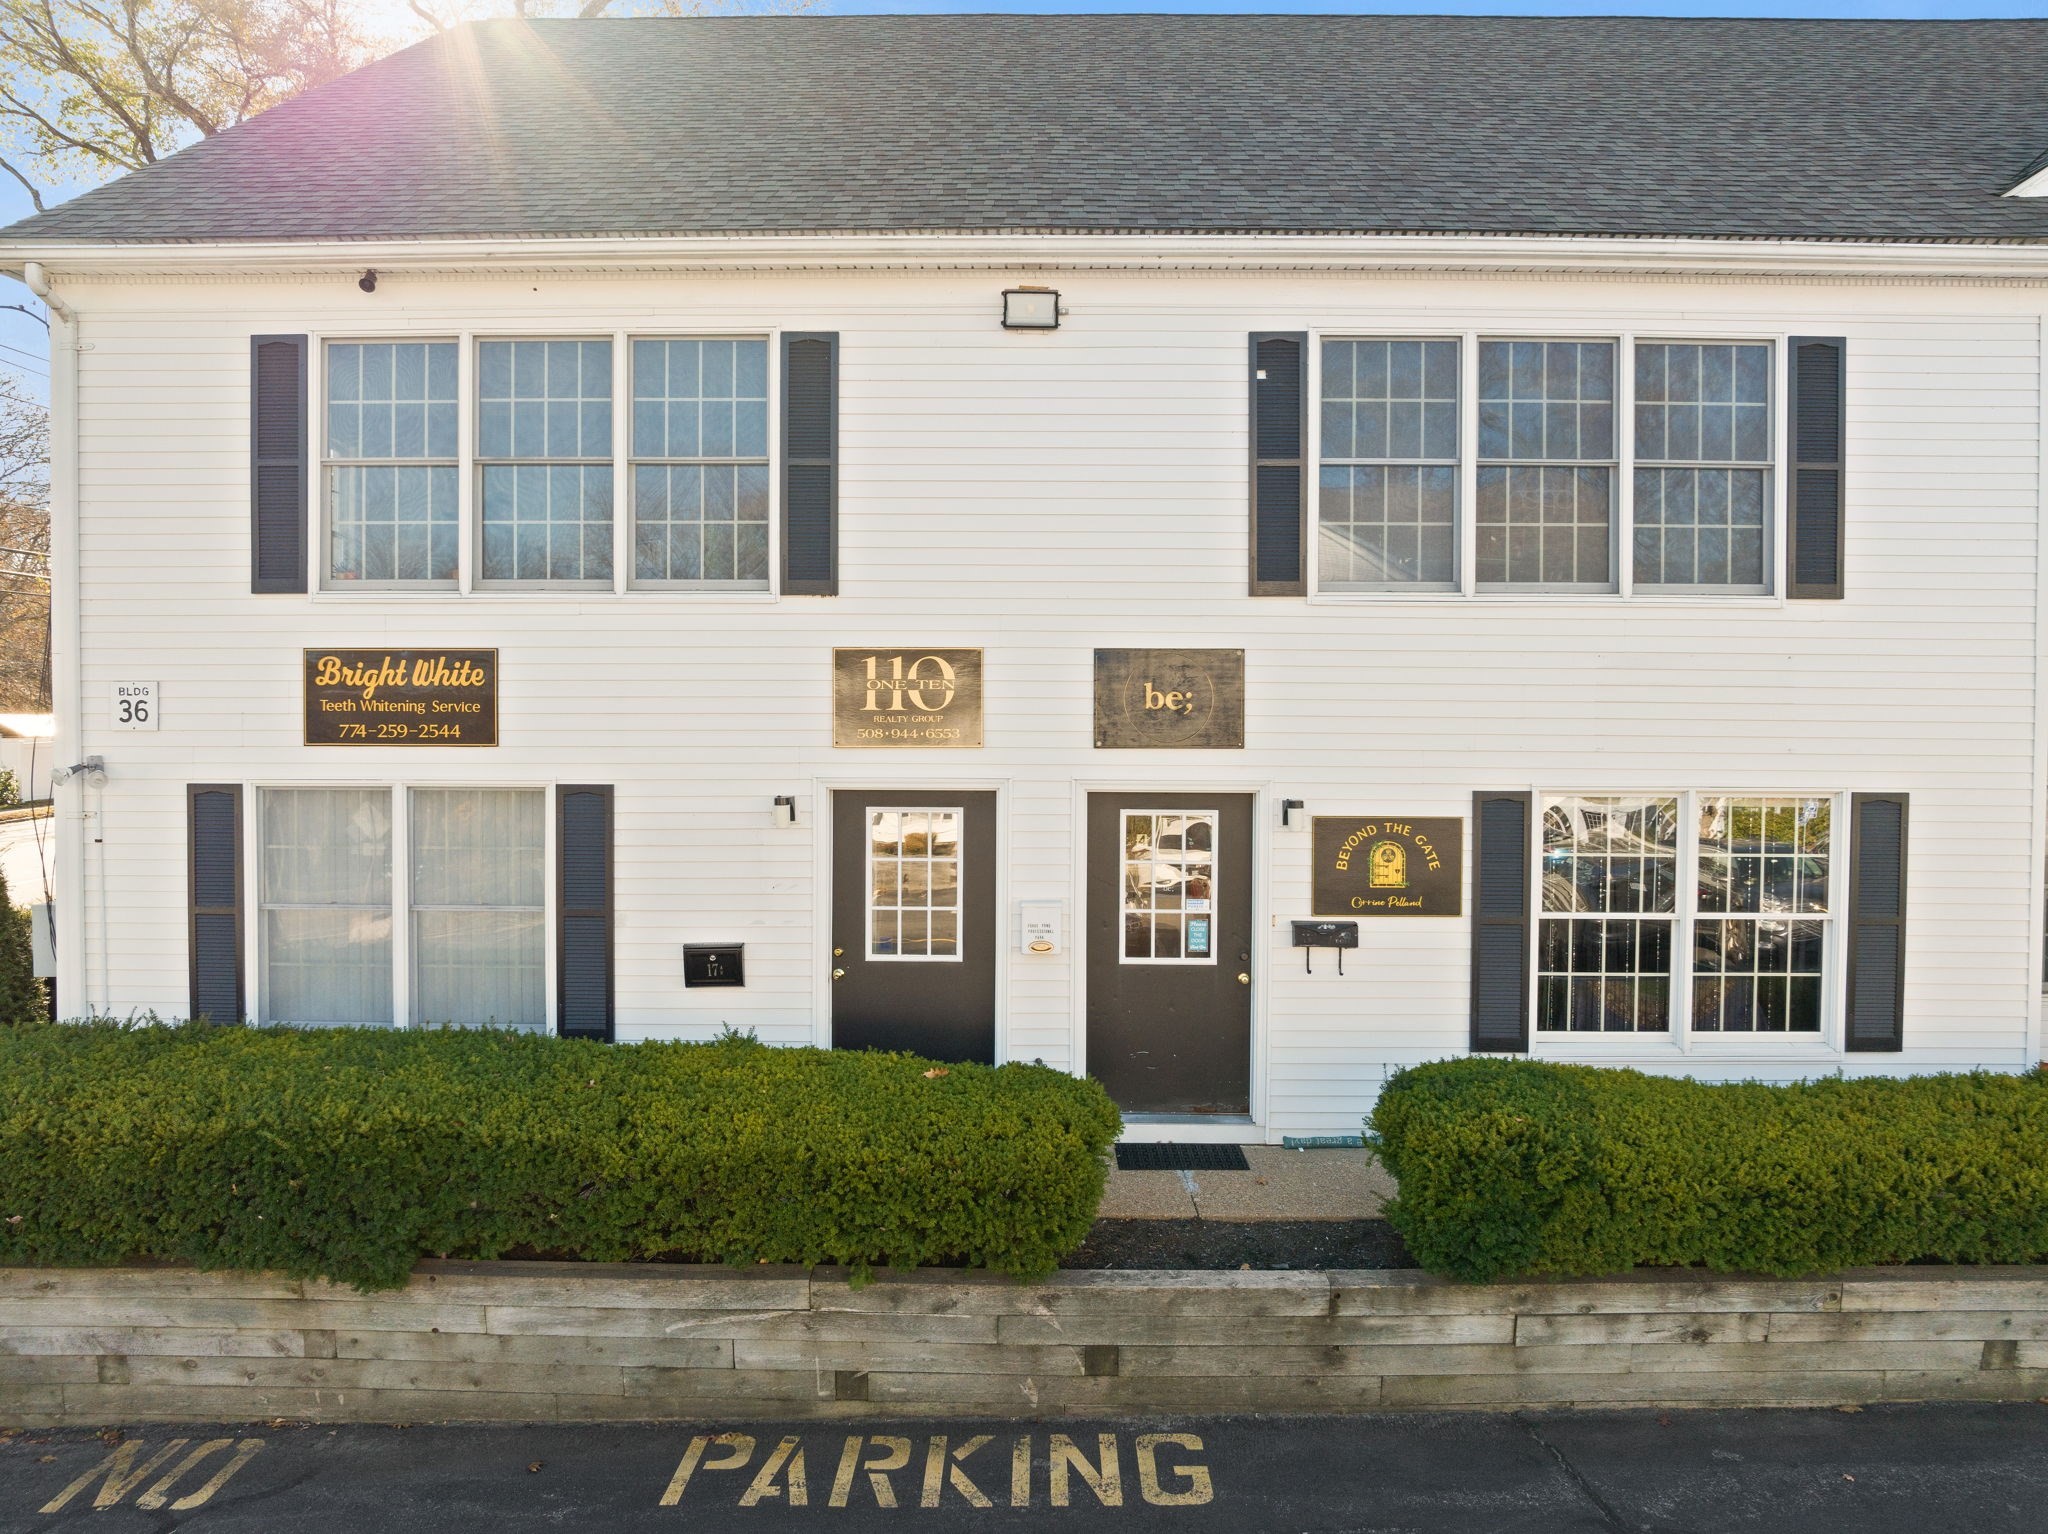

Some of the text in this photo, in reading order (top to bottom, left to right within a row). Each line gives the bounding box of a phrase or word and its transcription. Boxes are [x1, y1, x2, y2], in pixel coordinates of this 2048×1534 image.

[315, 655, 485, 700] Bright White
[866, 679, 955, 690] ONE TEN
[118, 686, 149, 697] BLDG
[1143, 682, 1193, 715] be;
[119, 699, 149, 723] 36
[319, 699, 481, 715] Teeth Whitening Service
[873, 715, 944, 723] REALTY GROUP
[339, 723, 461, 738] 774-259-2544
[1336, 822, 1441, 871] BEYOND THE GATE
[1387, 896, 1423, 909] Pelland
[37, 1431, 1215, 1514] NO PARKING
